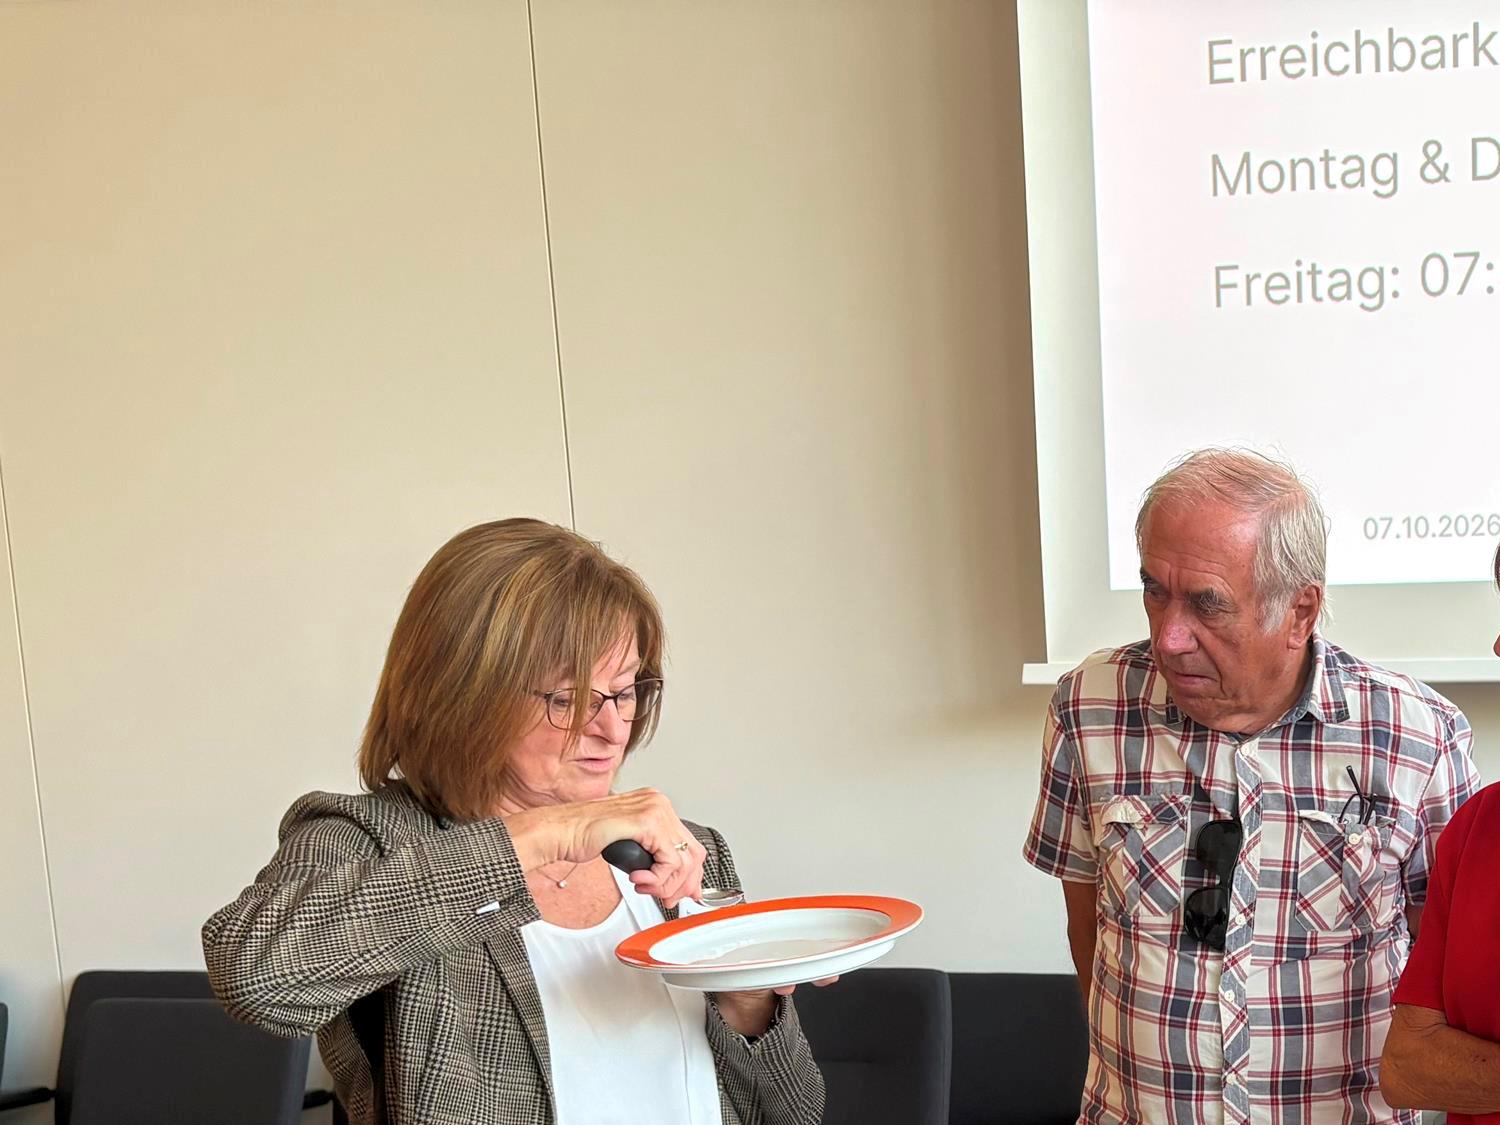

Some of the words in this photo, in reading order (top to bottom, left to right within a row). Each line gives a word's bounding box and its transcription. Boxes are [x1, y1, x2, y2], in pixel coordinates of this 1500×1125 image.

[1212, 149, 1398, 199] Montag
[1420, 139, 1451, 184] &
[1215, 259, 1399, 312] Freitag:
